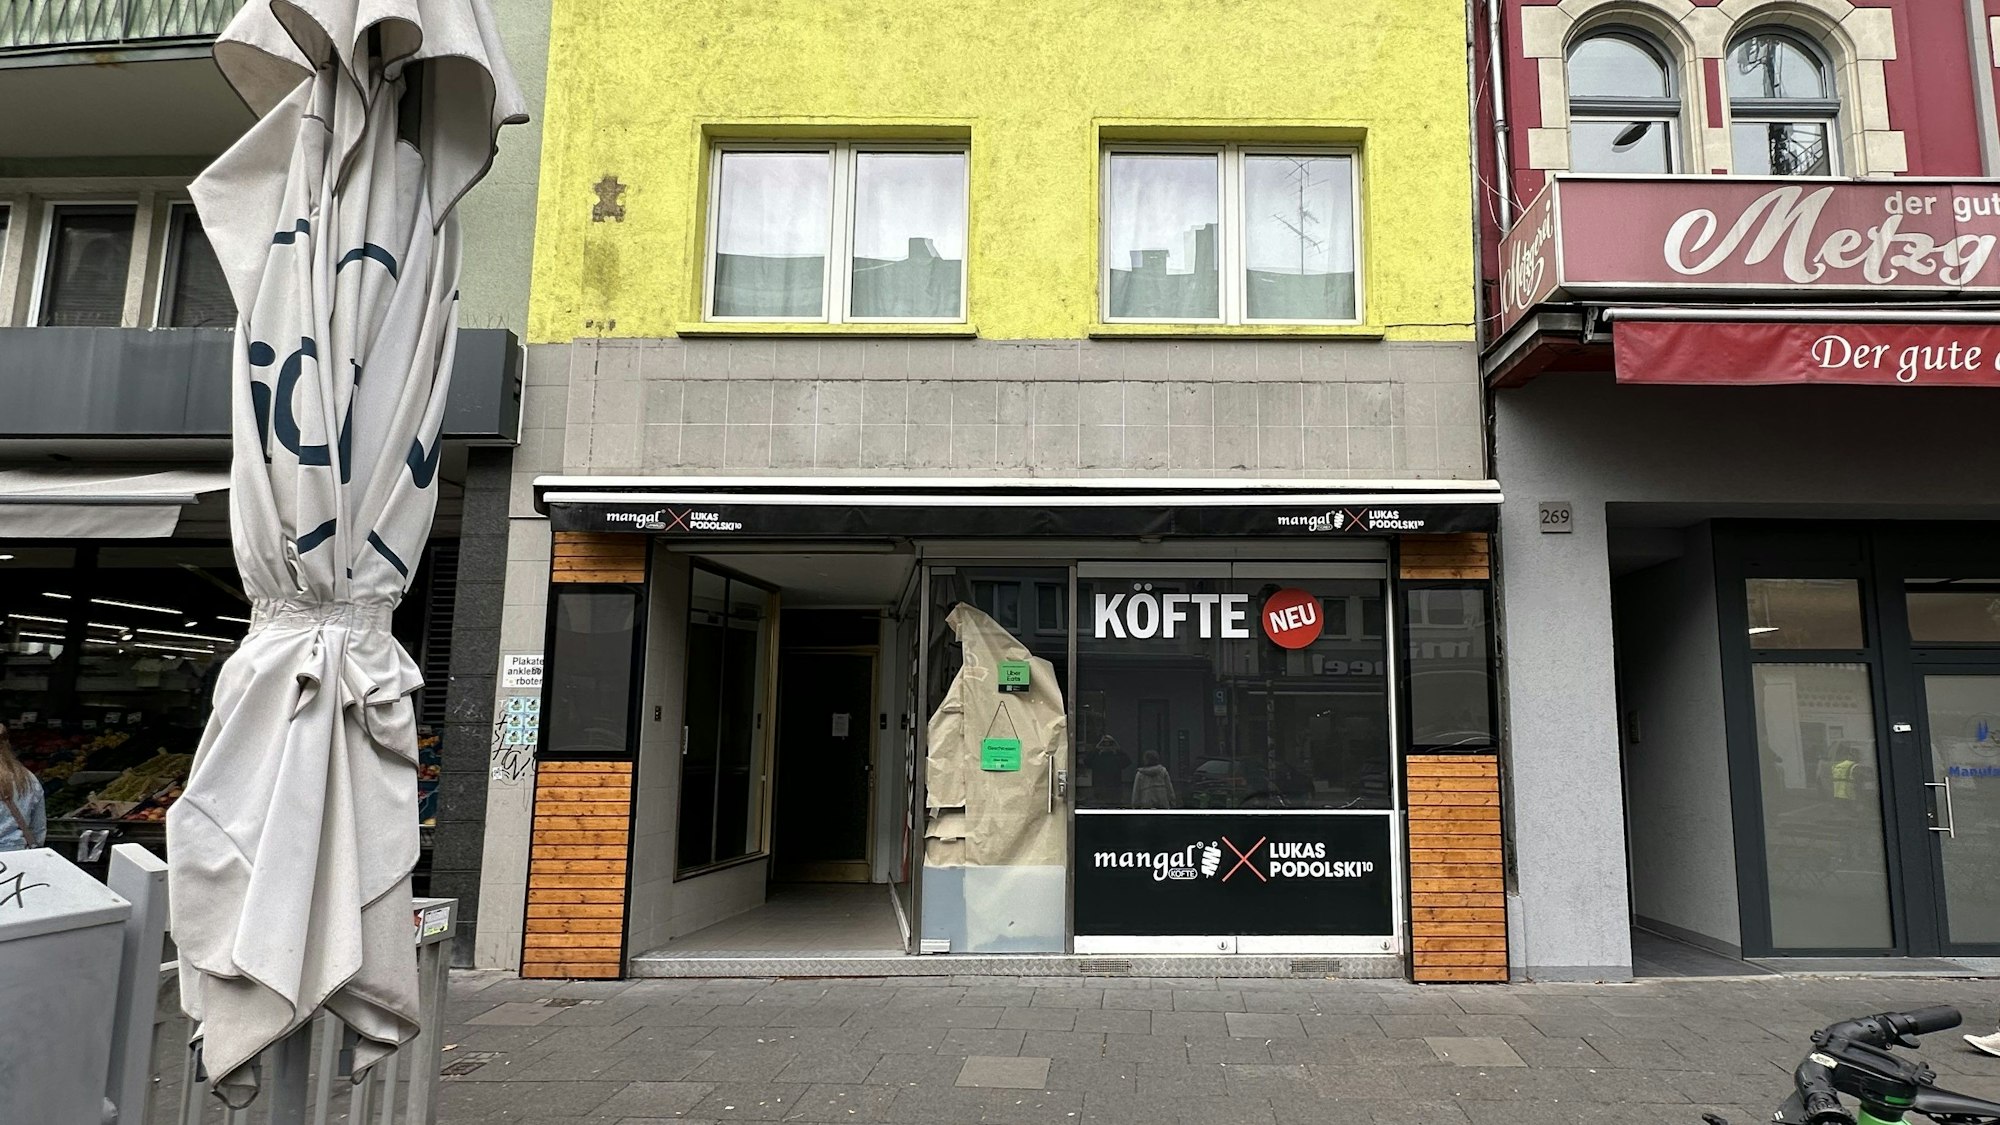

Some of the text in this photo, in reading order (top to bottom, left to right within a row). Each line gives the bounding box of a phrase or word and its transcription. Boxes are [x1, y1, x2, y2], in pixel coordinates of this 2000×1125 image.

[1884, 191, 1937, 215] der
[1502, 199, 1554, 314] Metzgerei
[1811, 334, 1890, 370] Der
[1896, 340, 1982, 383] gute
[606, 511, 663, 529] mangal
[691, 512, 719, 522] LUKAS
[1278, 511, 1331, 531] mangal
[1369, 510, 1399, 519] LUKAS
[1541, 509, 1570, 524] 269
[1094, 582, 1250, 639] KÖFTE
[1268, 602, 1317, 634] NEU
[1270, 842, 1326, 859] LUKAS
[1093, 844, 1195, 881] mangal
